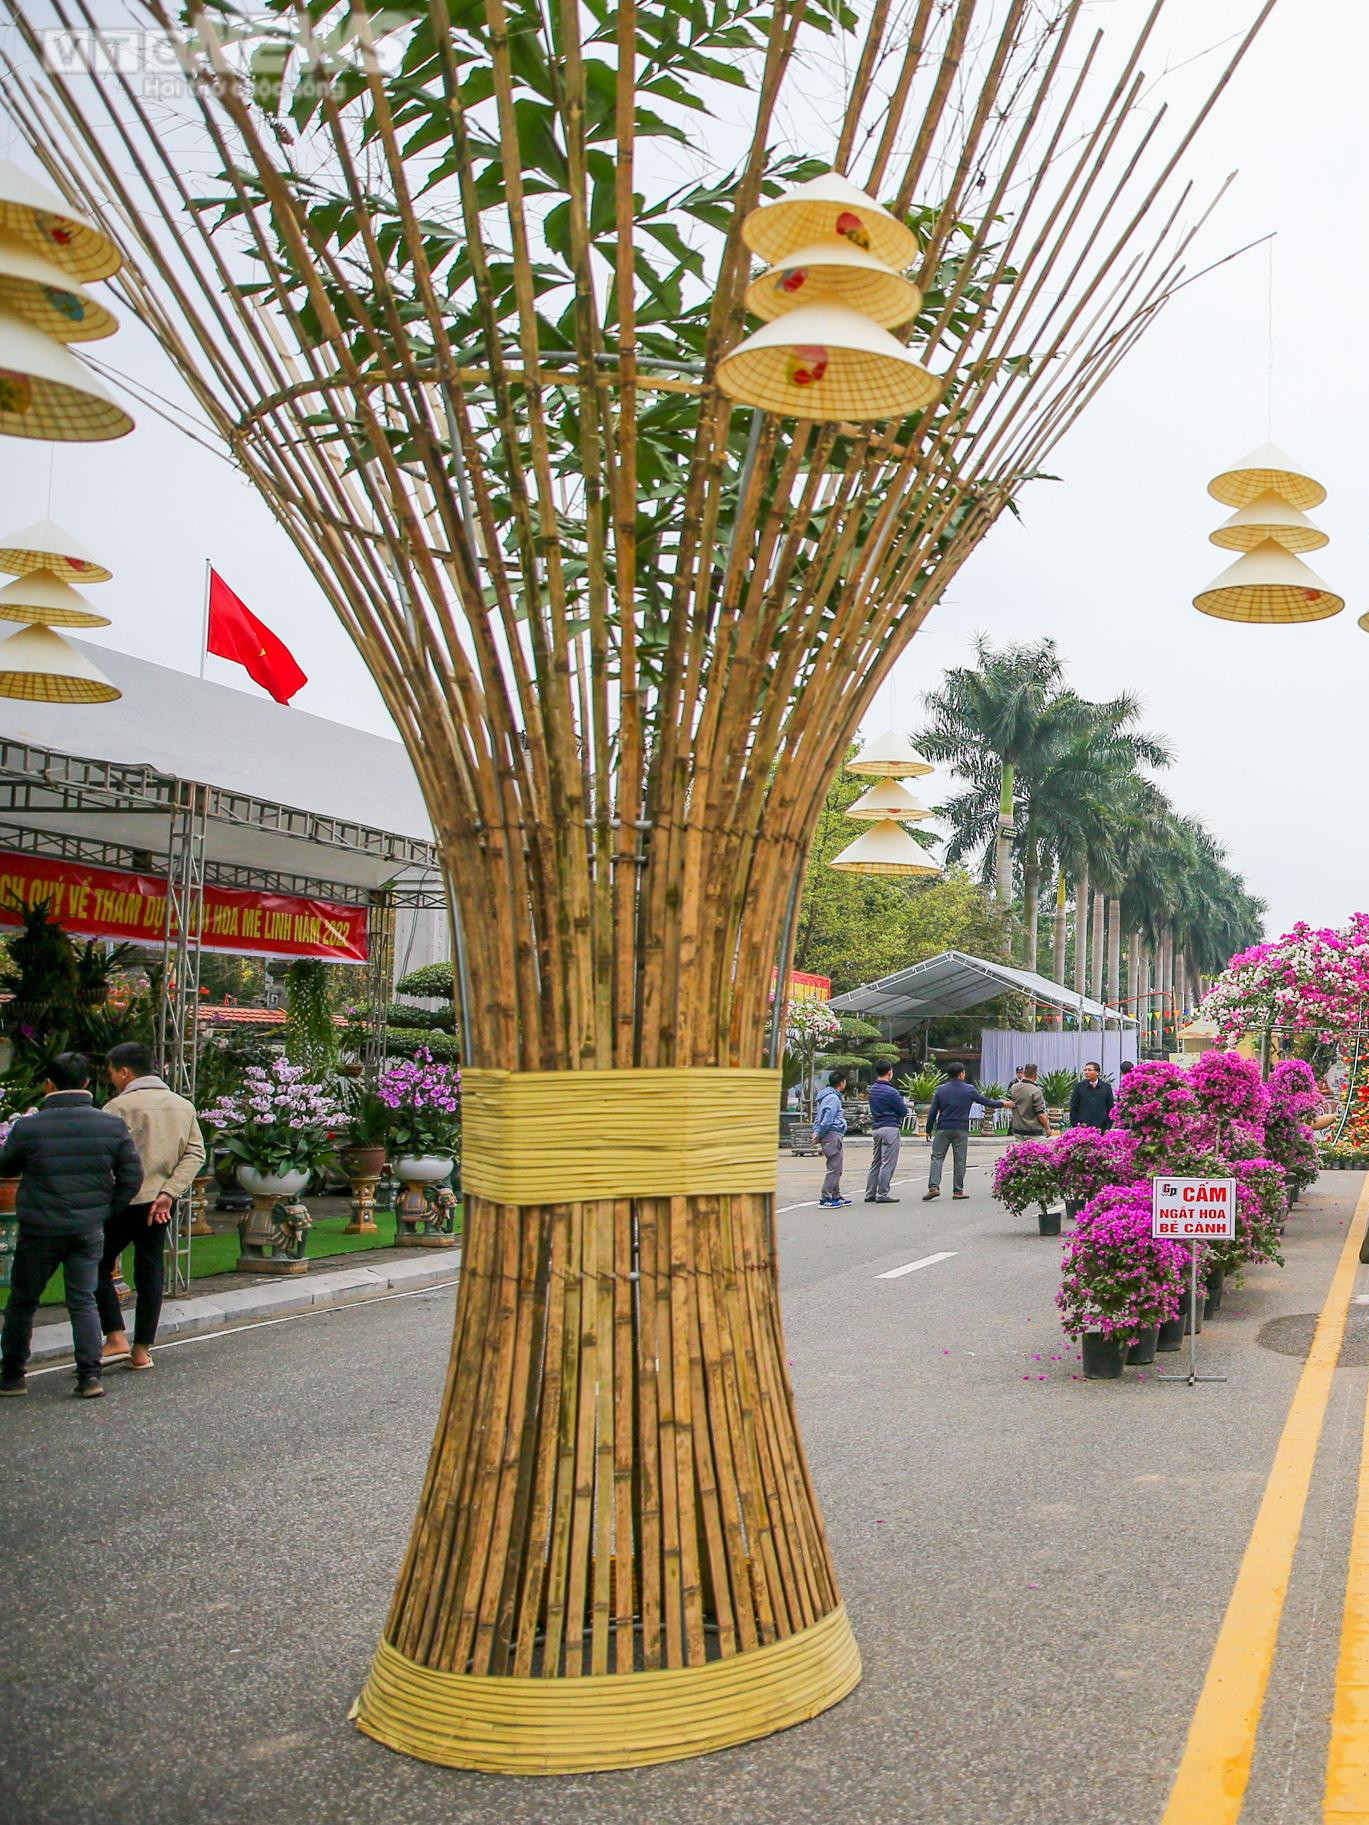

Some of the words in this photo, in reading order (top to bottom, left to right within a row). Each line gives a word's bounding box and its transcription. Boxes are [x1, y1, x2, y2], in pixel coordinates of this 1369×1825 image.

[94, 888, 143, 926] THAM
[213, 903, 239, 937] HOA
[242, 903, 262, 938] MÊ
[265, 912, 291, 941] LINH
[294, 910, 321, 945] NĂM
[322, 920, 351, 948] 2022
[1183, 1181, 1227, 1203] CẤM
[1199, 1209, 1226, 1219] HOA
